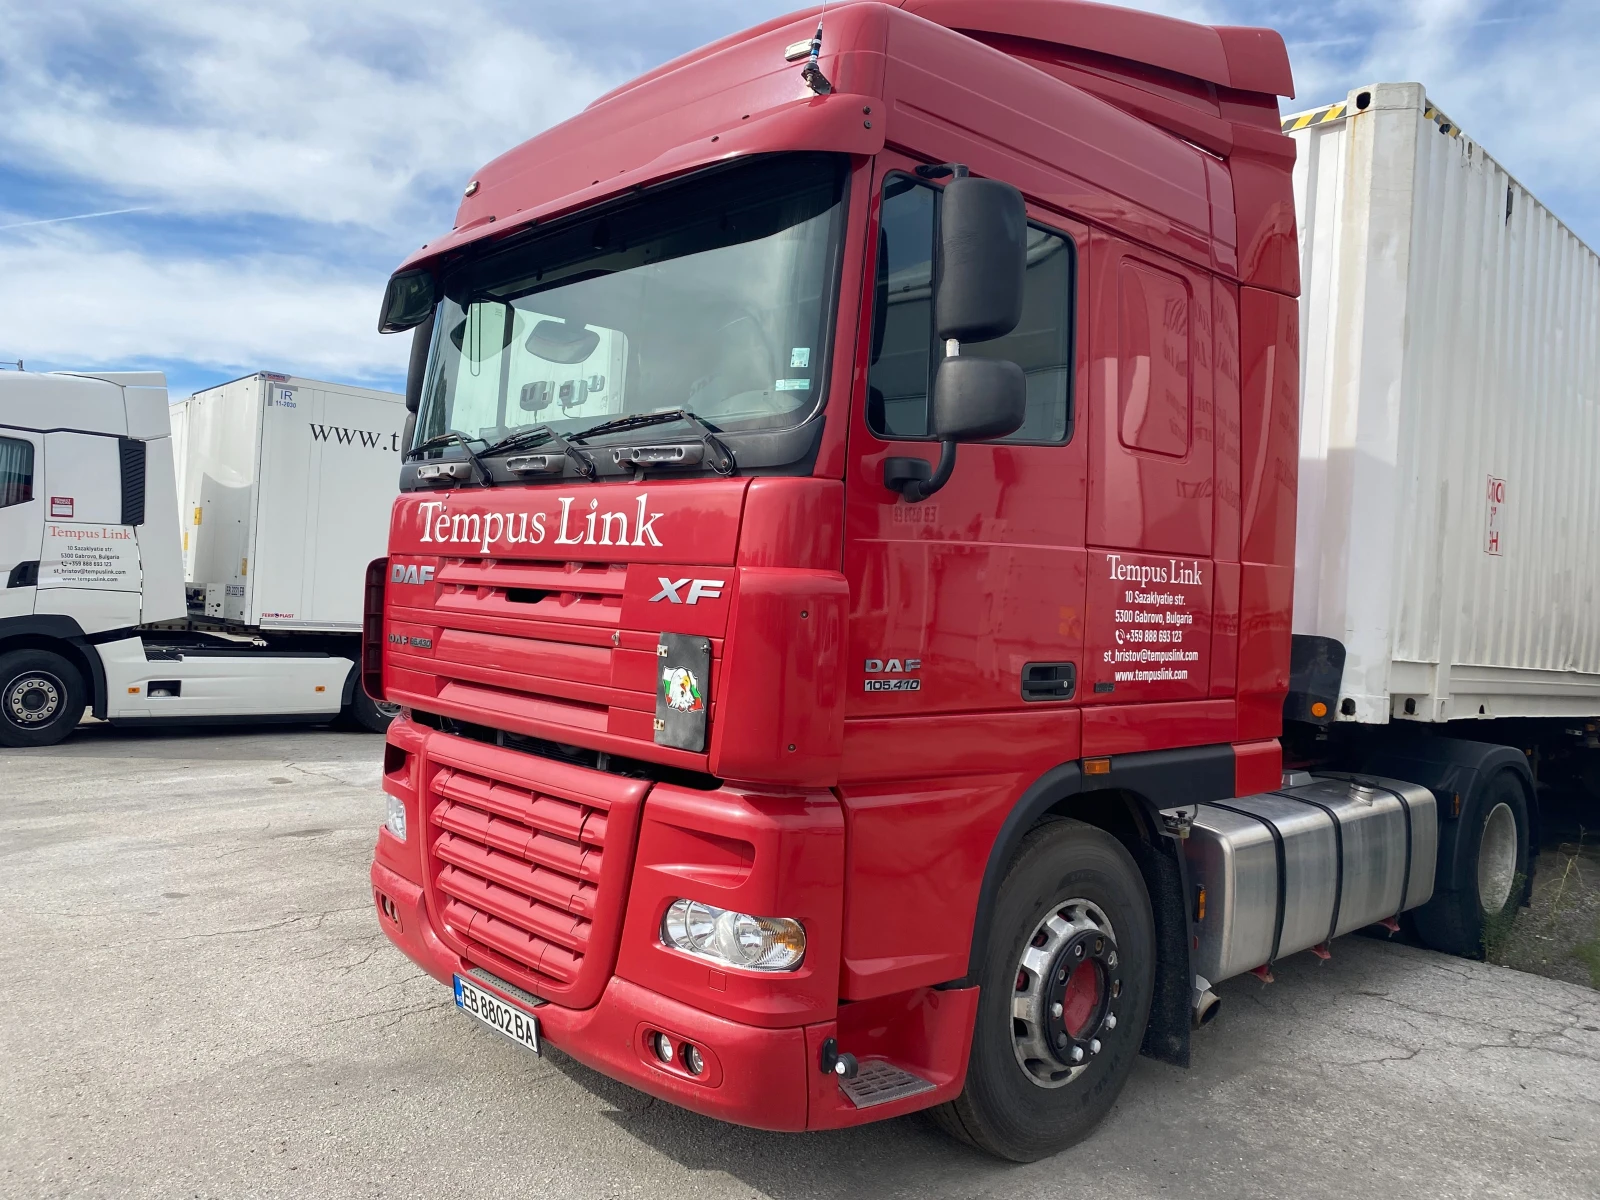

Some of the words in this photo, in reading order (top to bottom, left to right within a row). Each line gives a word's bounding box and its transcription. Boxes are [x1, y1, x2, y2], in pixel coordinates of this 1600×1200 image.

[280, 390, 293, 401] IR
[418, 501, 546, 553] Tempus
[554, 493, 664, 547] Link
[48, 526, 100, 540] Tempus
[102, 527, 131, 540] Link
[391, 563, 436, 585] DAF
[1106, 554, 1168, 588] Tempus
[1169, 559, 1203, 585] Link
[647, 577, 726, 605] XF
[1125, 590, 1133, 603] 10
[1134, 591, 1174, 607] Sazaklyatie
[1174, 593, 1186, 606] str.
[1115, 609, 1133, 623] 5300
[1134, 611, 1165, 626] Gabrovo,
[1165, 611, 1193, 626] Bulgaria
[389, 633, 409, 645] DAF
[1126, 630, 1143, 643] +359
[1144, 630, 1158, 643] 888
[1158, 630, 1171, 643] 693
[1172, 630, 1183, 643] 123
[1103, 649, 1199, 664] st_hristov@tempuslink.com
[864, 658, 922, 673] DAF
[1115, 668, 1188, 683] www.tempuslink.com
[866, 680, 920, 691] 105.410
[462, 983, 479, 1014] EB
[480, 995, 514, 1035] 8802
[514, 1013, 535, 1047] BA
